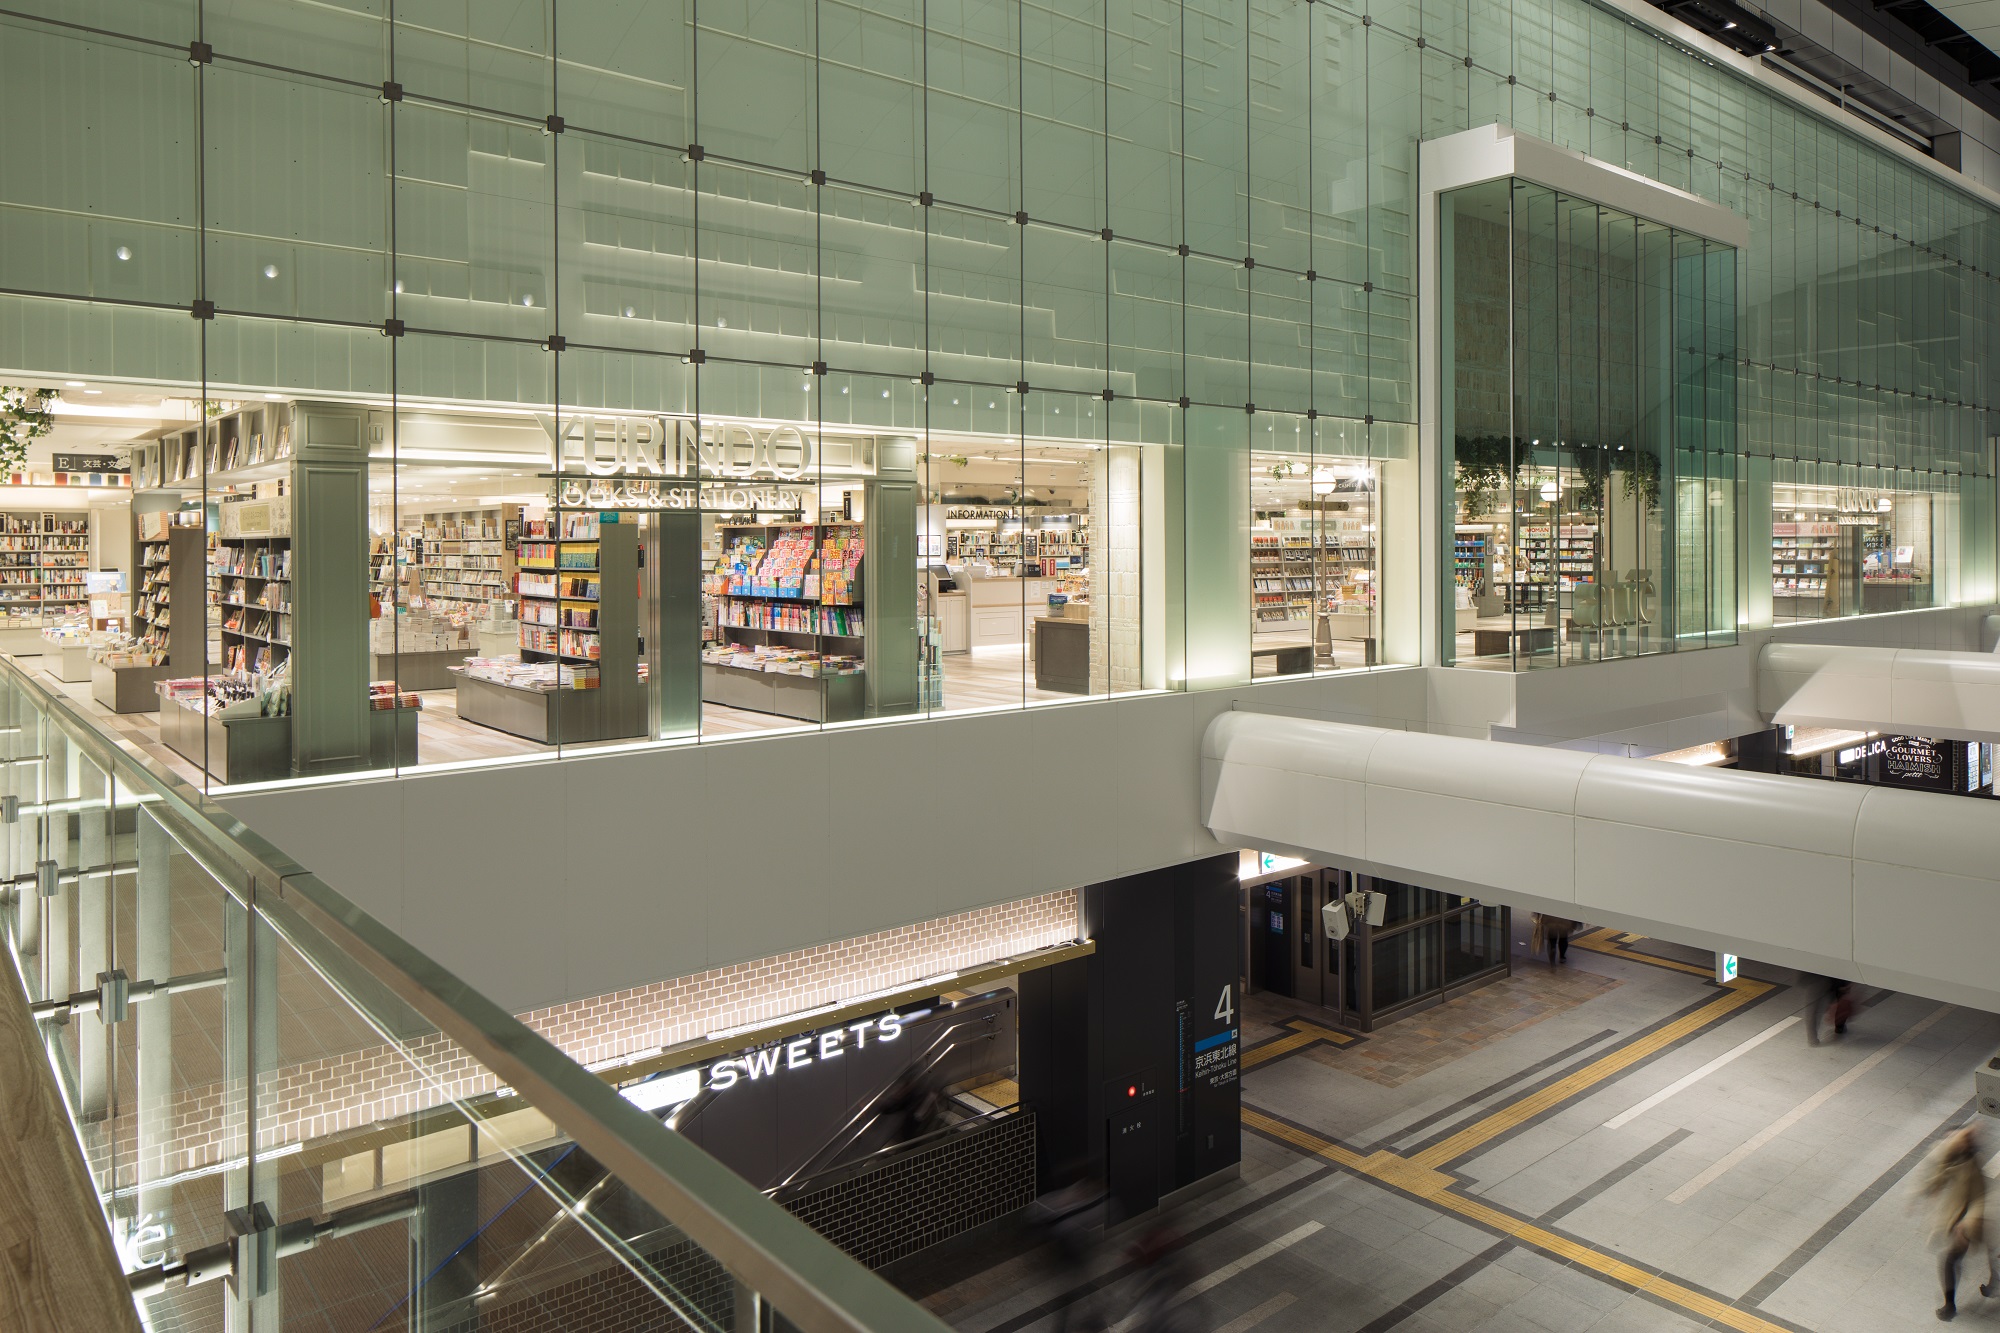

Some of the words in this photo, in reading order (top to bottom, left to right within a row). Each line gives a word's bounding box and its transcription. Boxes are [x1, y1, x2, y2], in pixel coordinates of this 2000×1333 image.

[533, 413, 812, 479] YURINDO
[58, 457, 70, 469] E
[83, 459, 117, 469] 文芸・文
[647, 487, 664, 507] &
[669, 487, 802, 510] STATIONERY
[946, 509, 1010, 520] INFORMATION
[1855, 740, 1887, 760] DELICA
[1891, 746, 1937, 757] GOURMET
[1896, 753, 1932, 763] LOVERS
[1887, 760, 1941, 774] HAIMISH
[1214, 984, 1234, 1025] 4
[710, 1014, 902, 1091] SWEETS
[1194, 1043, 1237, 1070] 京浜東北線
[1227, 1058, 1237, 1067] Line
